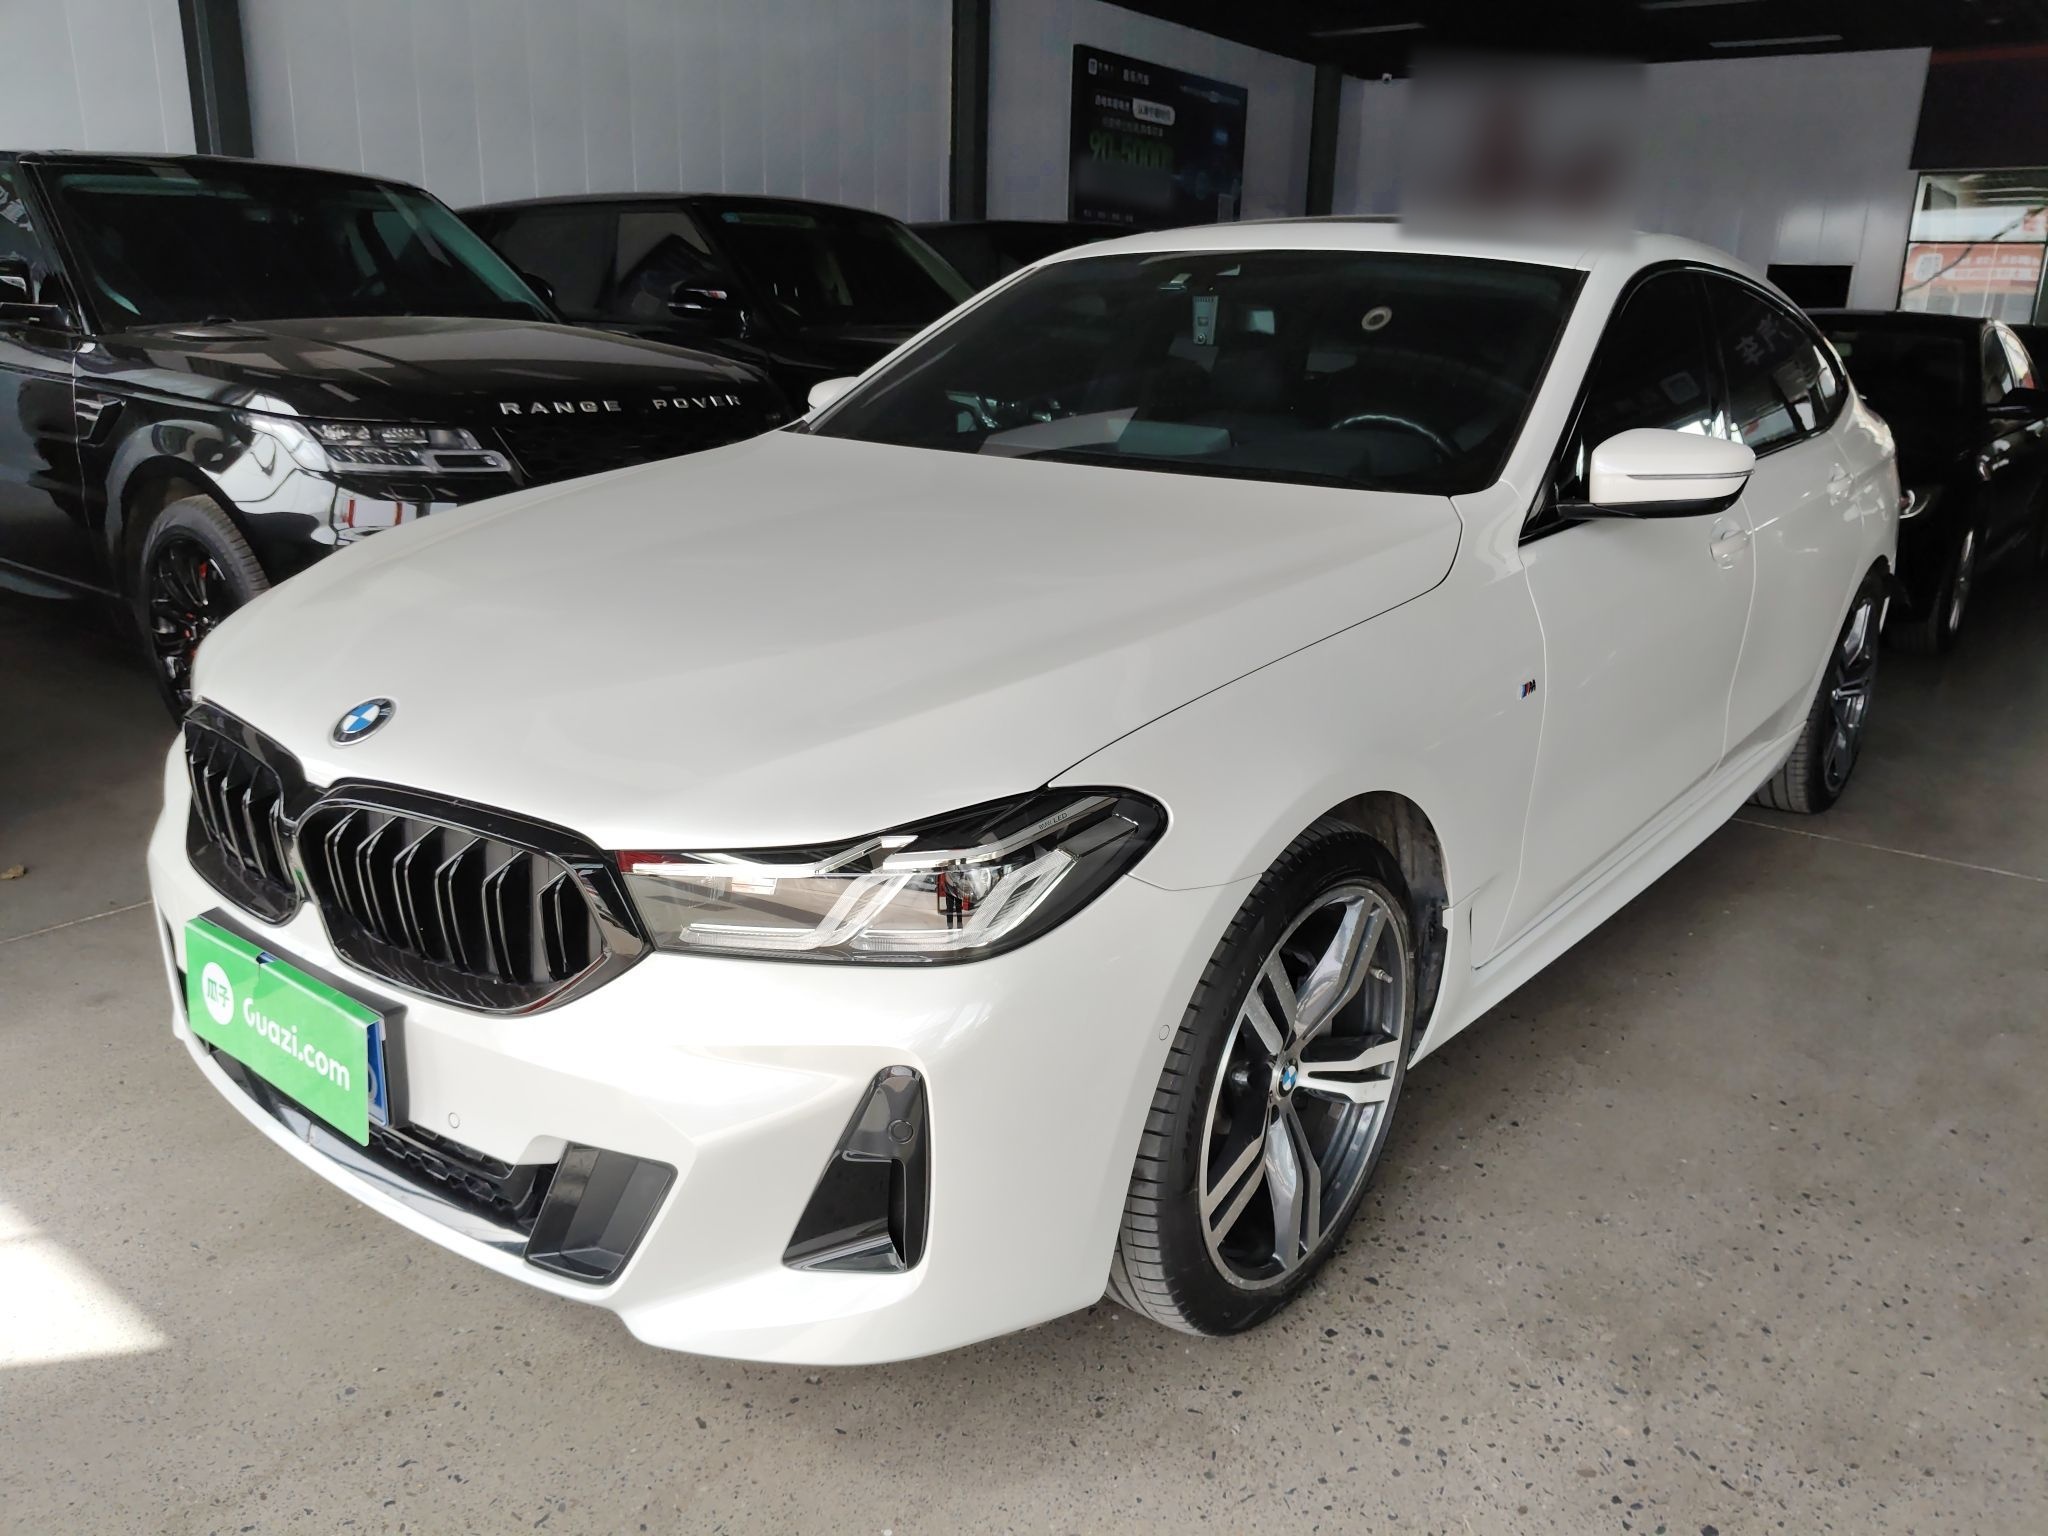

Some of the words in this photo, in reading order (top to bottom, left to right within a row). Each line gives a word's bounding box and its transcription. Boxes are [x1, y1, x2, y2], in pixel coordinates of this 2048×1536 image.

[500, 401, 622, 415] RANGE
[652, 394, 741, 410] ROVER
[1053, 813, 1068, 824] LED
[207, 977, 230, 1008] 瓜子
[243, 997, 350, 1092] Guazi.com
